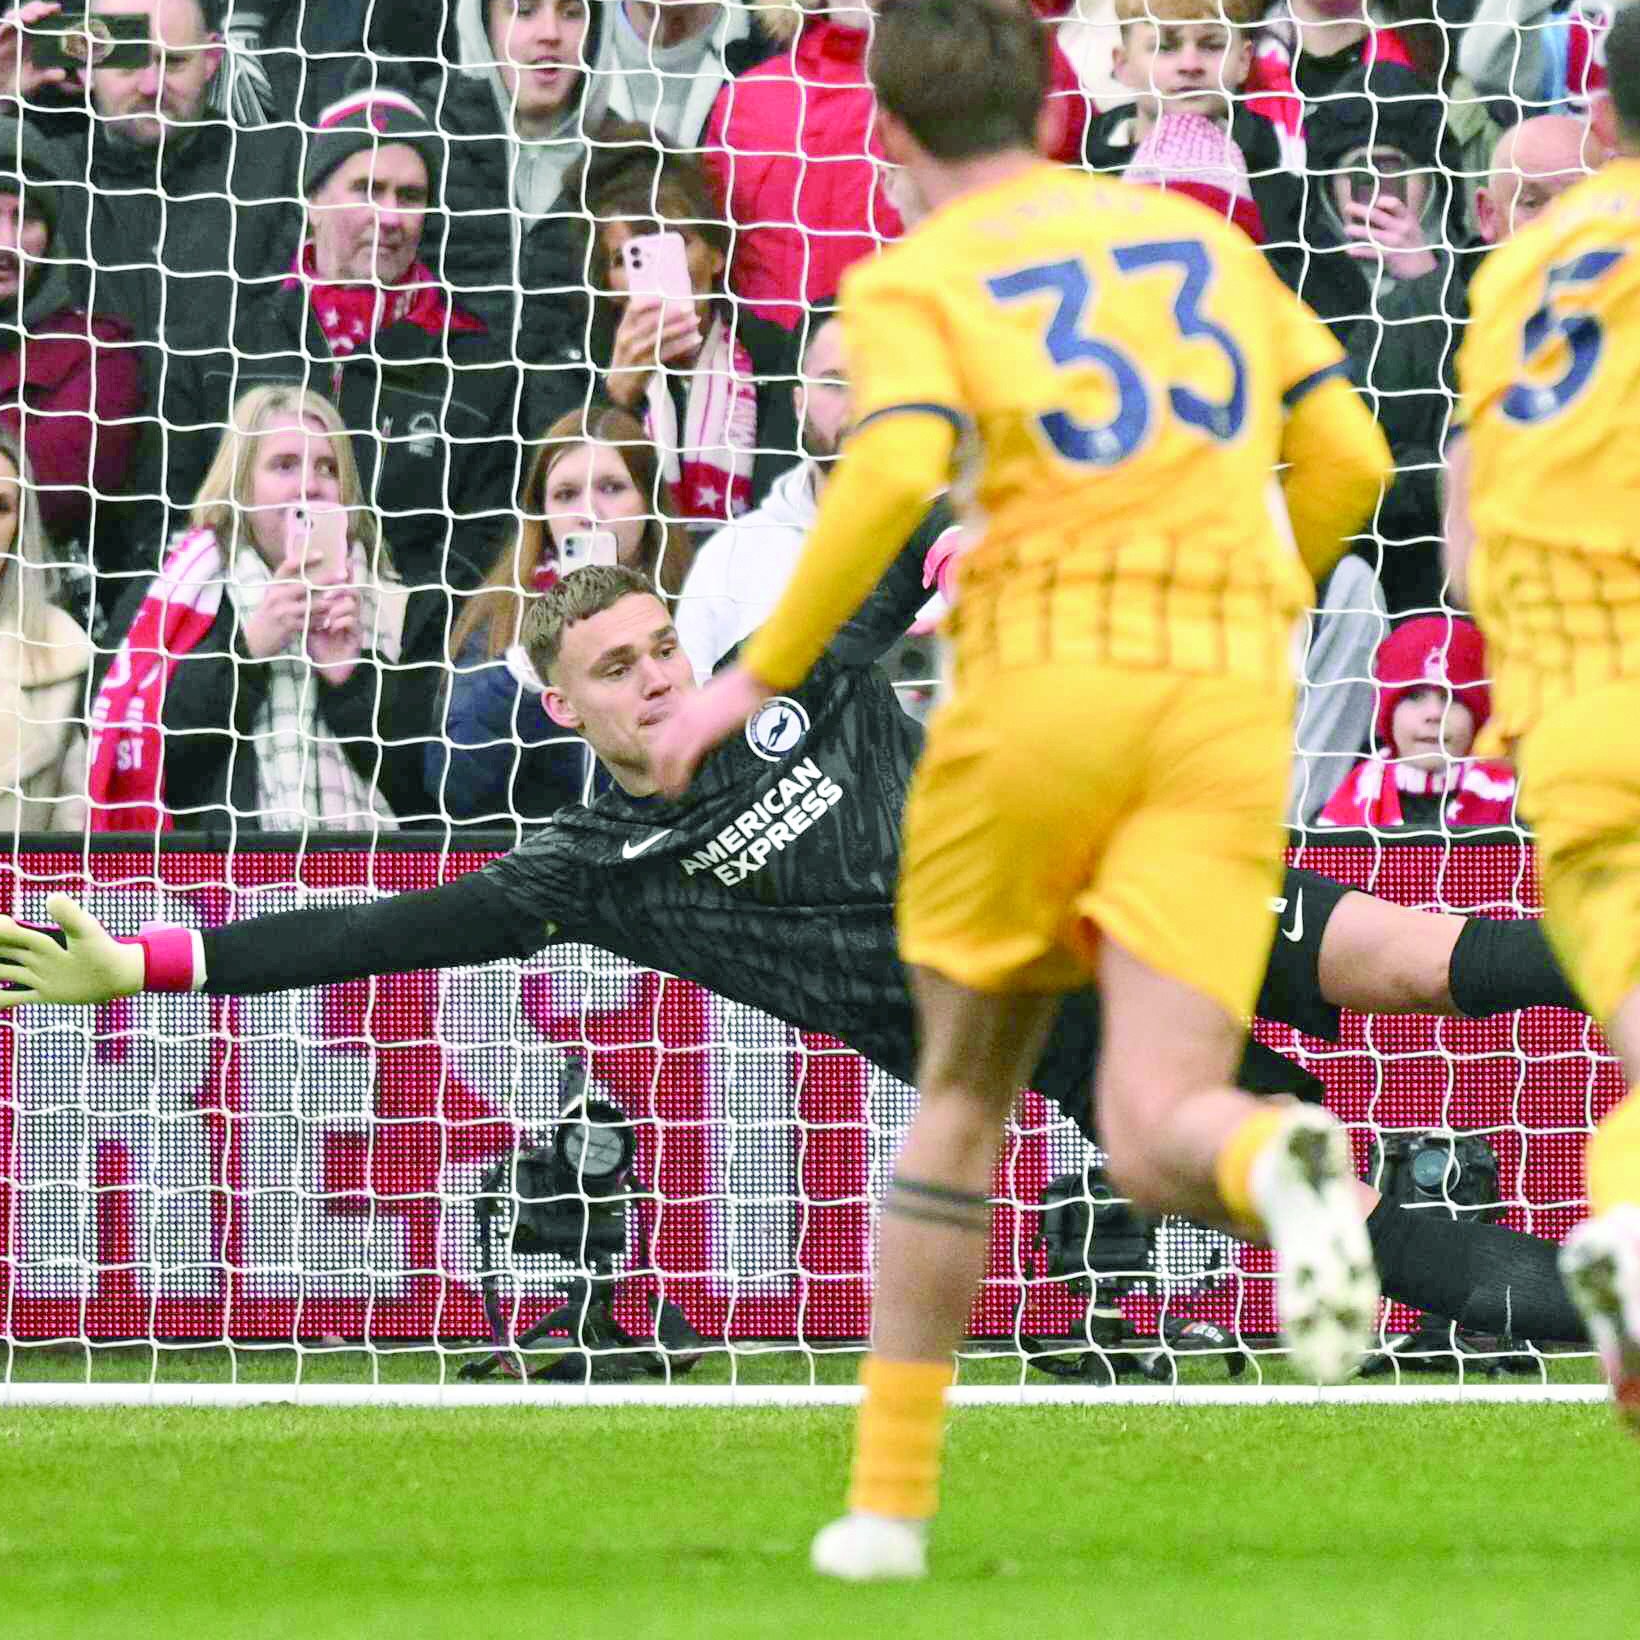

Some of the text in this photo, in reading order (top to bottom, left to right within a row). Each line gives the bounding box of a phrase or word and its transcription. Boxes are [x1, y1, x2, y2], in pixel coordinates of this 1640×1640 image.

[987, 238, 1249, 466] 33
[1500, 247, 1626, 423] 5
[680, 757, 823, 875] AMERICAN
[713, 776, 843, 886] EXPRESS
